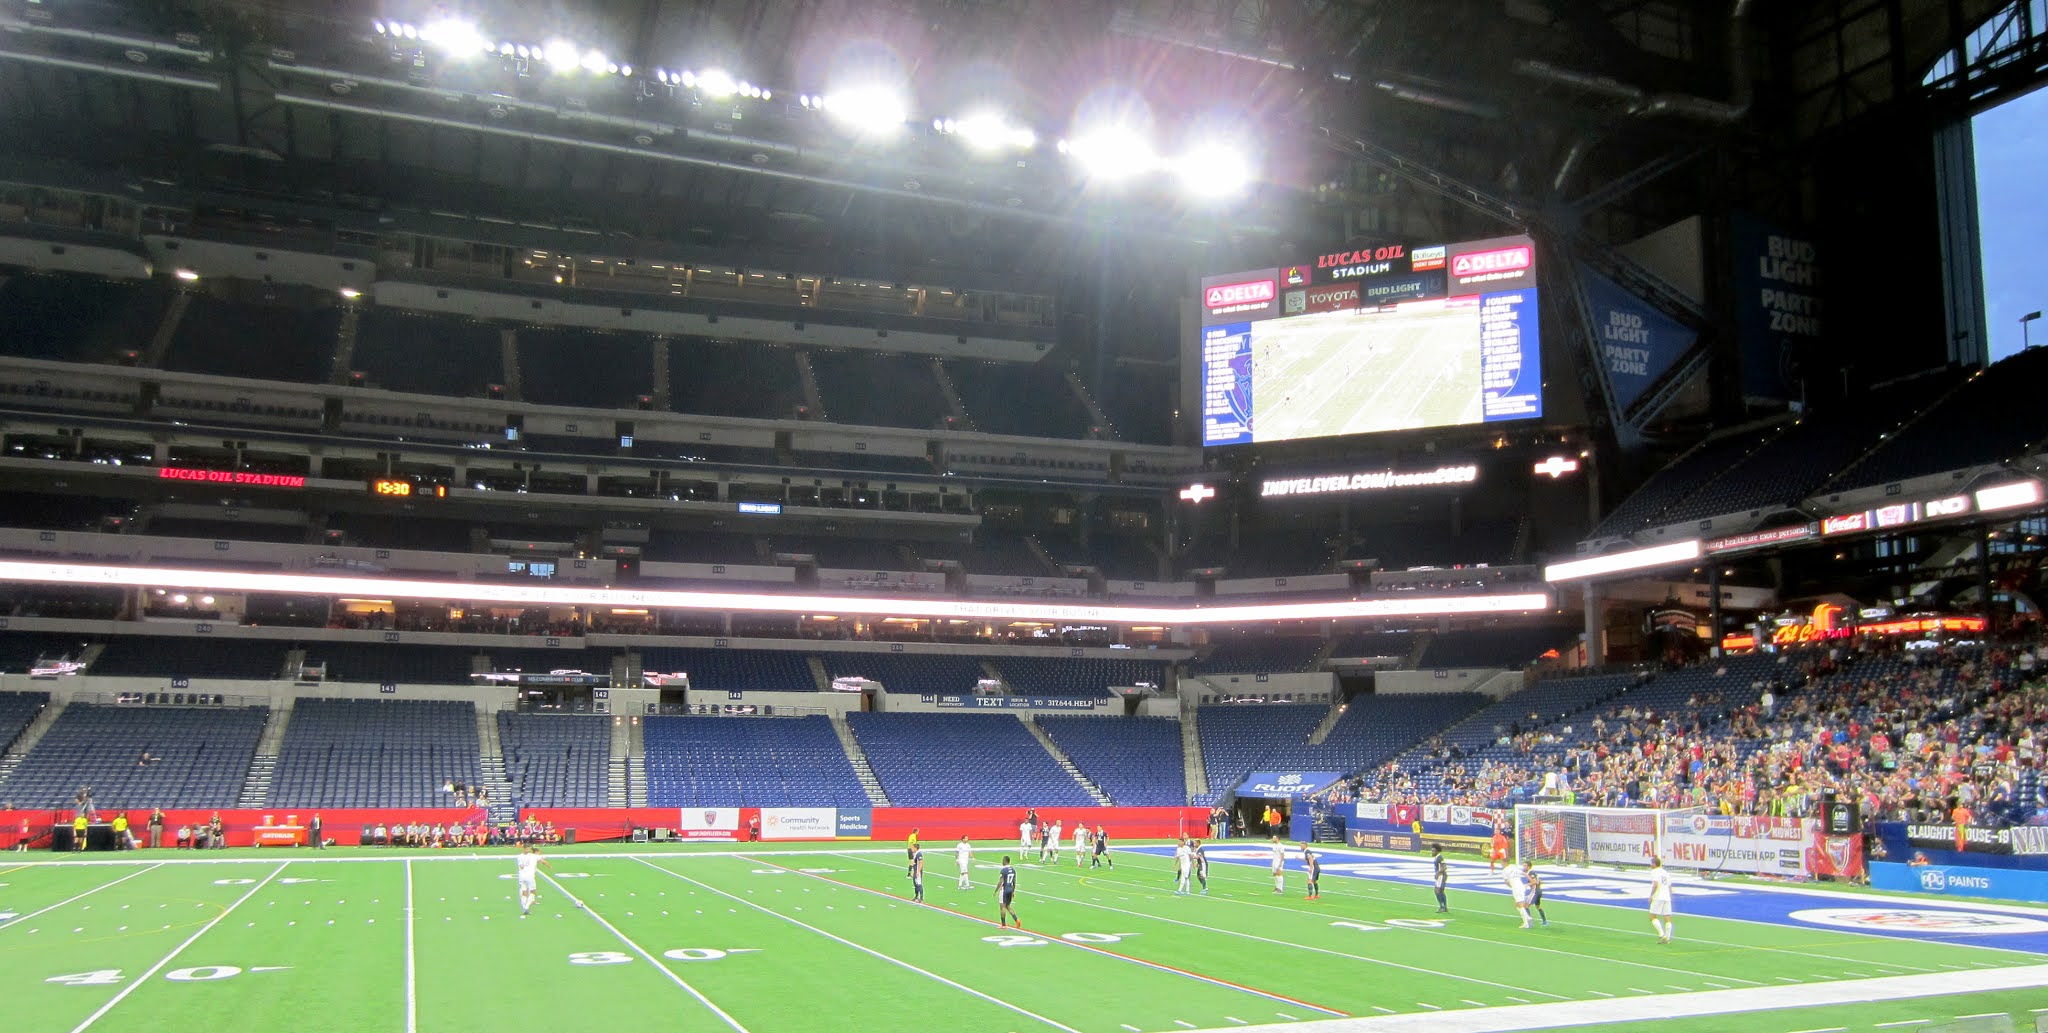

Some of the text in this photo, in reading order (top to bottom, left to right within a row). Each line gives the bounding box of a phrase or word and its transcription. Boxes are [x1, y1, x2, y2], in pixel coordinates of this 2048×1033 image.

[1318, 245, 1404, 267] LUCAS OIL
[1768, 235, 1816, 262] BUD
[1472, 251, 1525, 270] DELTA
[1333, 263, 1390, 279] STADIUM
[1223, 284, 1271, 301] DELTA
[1310, 289, 1358, 304] TOYOTA
[1368, 282, 1421, 297] BUD LIGHT
[1609, 311, 1642, 328] BUD
[1604, 324, 1649, 344] LIGHT
[1606, 344, 1650, 364] PARTY
[1611, 359, 1647, 376] ZONE
[160, 468, 304, 487] LUCAS OIL STADIUM
[377, 482, 410, 495] 15:30
[1724, 531, 1758, 547] healthcare
[1759, 531, 1777, 541] more
[976, 697, 1004, 707] TEXT
[781, 816, 820, 825] Community
[1628, 843, 1640, 853] THE
[1642, 840, 1707, 862] AL-NEW
[1728, 849, 1757, 861] ELEVEN
[1760, 851, 1775, 861] APP
[1922, 872, 1988, 889] PPG PAINTS
